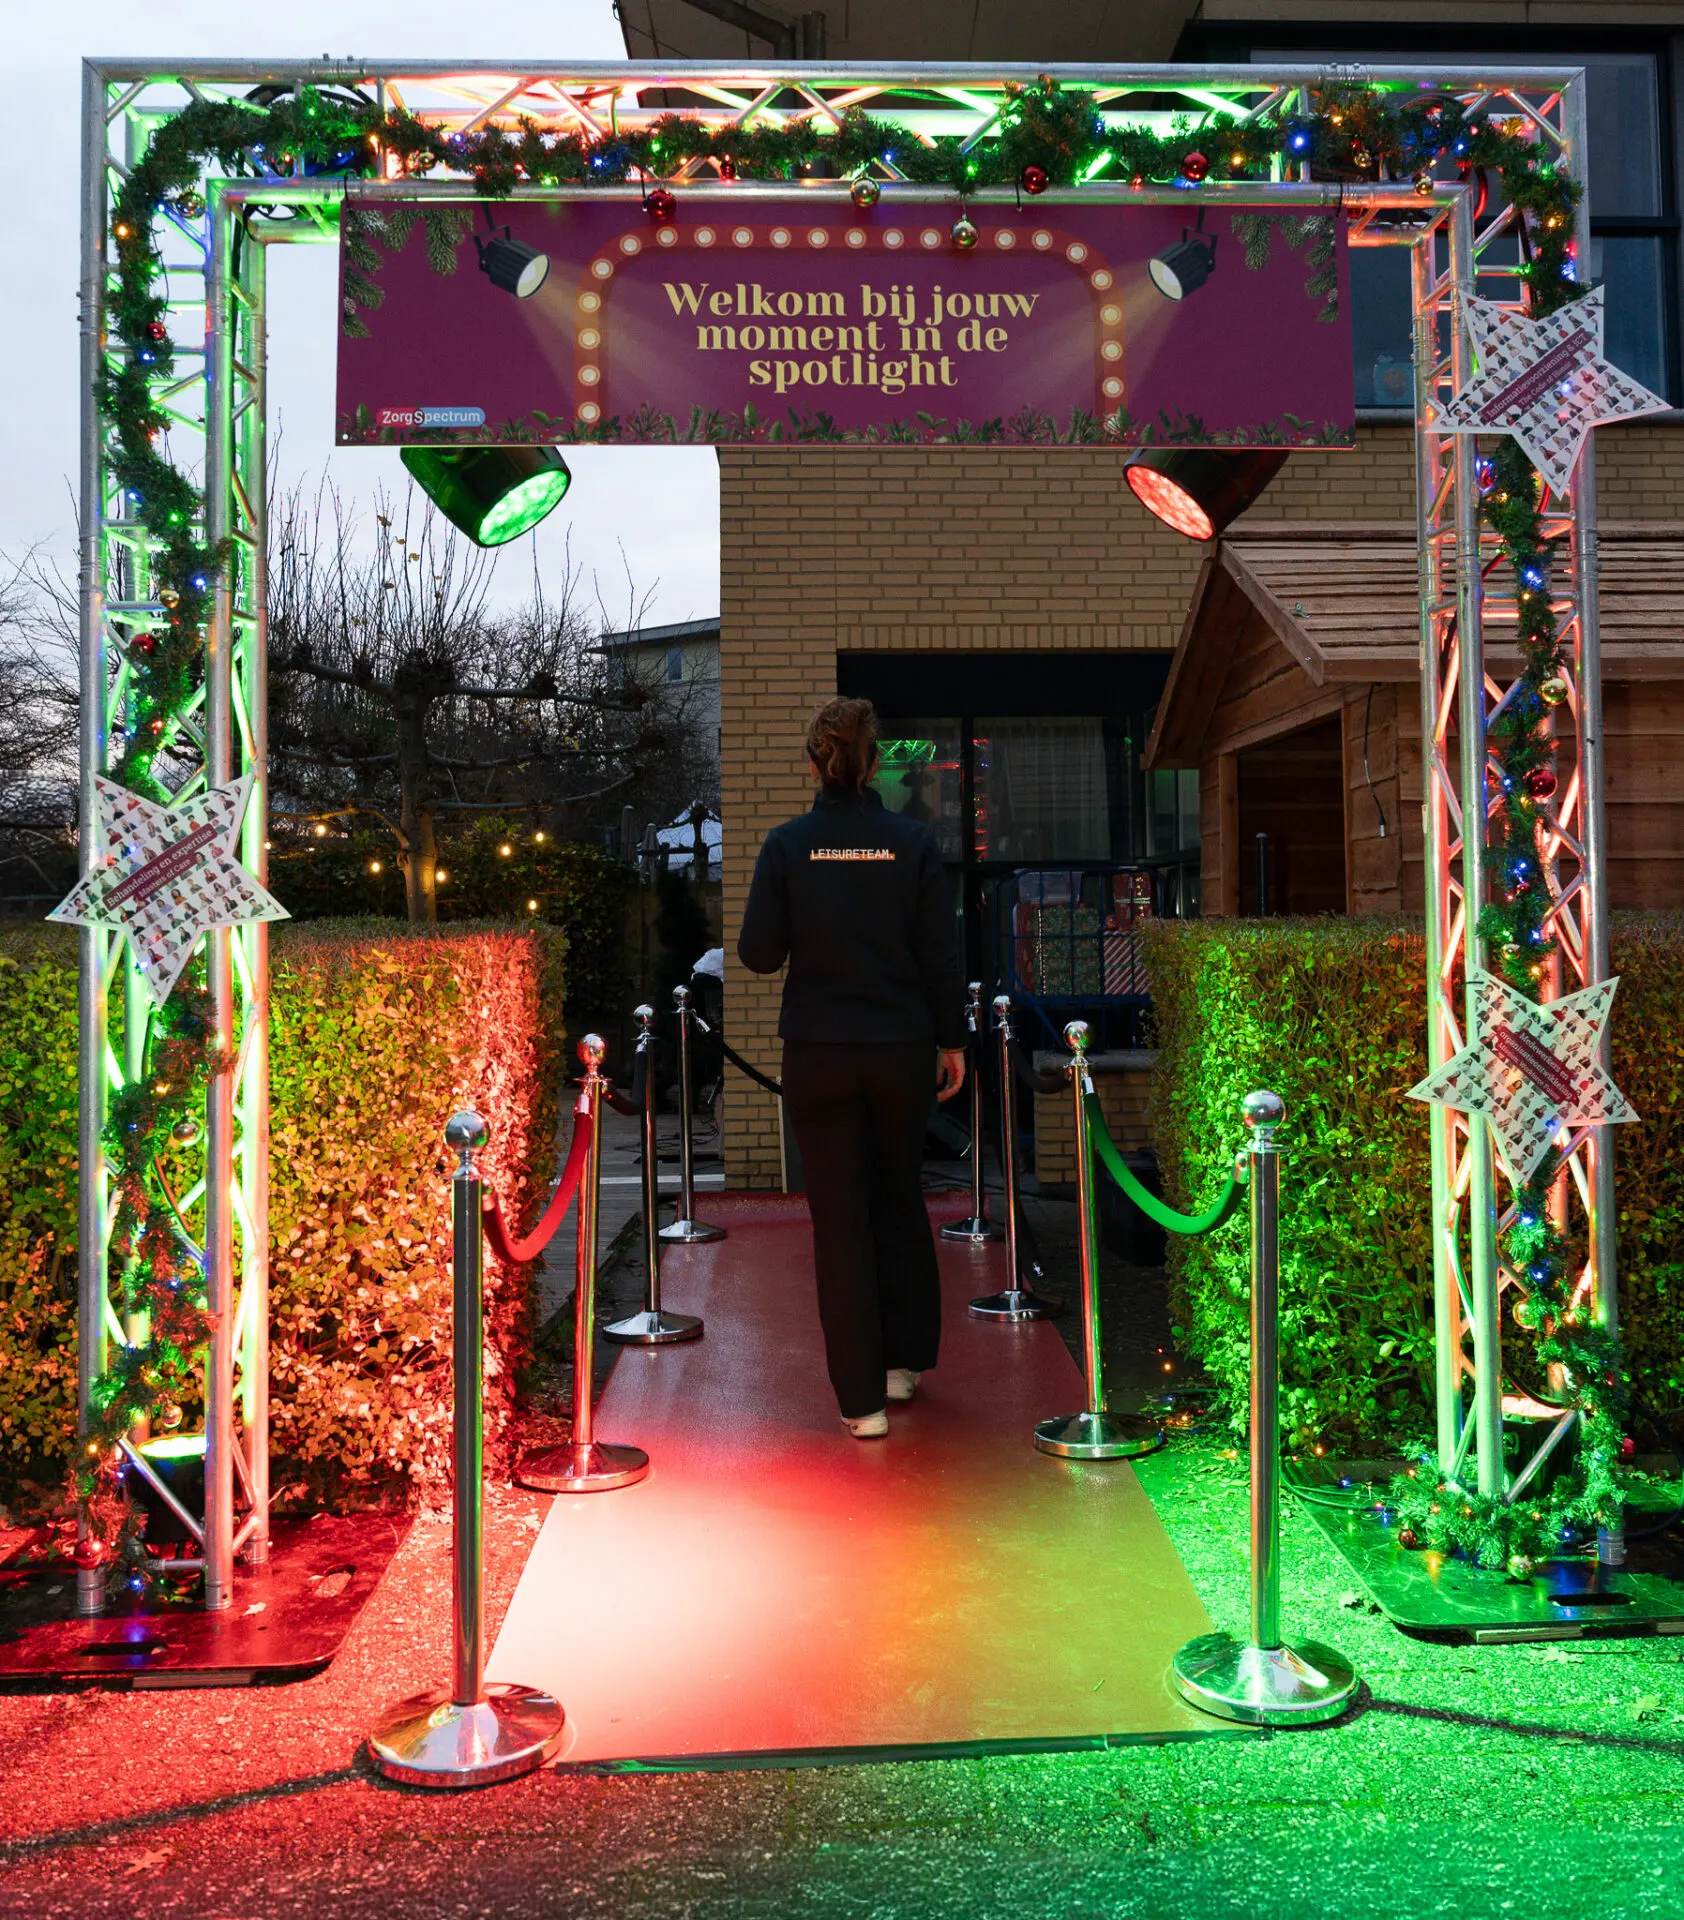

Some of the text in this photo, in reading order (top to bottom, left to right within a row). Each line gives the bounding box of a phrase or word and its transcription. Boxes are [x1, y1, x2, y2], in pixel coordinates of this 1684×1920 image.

[662, 283, 1040, 325] Welkom bij jouw
[696, 319, 1009, 353] moment in de
[749, 353, 959, 395] spotlight
[1486, 332, 1587, 417] Informatievoorziening & ICT
[1545, 374, 1554, 384] of
[382, 409, 481, 424] ZorgSpectrum
[106, 829, 213, 907] Behandeling en expertise
[139, 858, 191, 897] Masters of Care
[1499, 1031, 1573, 1099] organisatieontwikkeling
[1519, 1033, 1569, 1080] Medewerkers en
